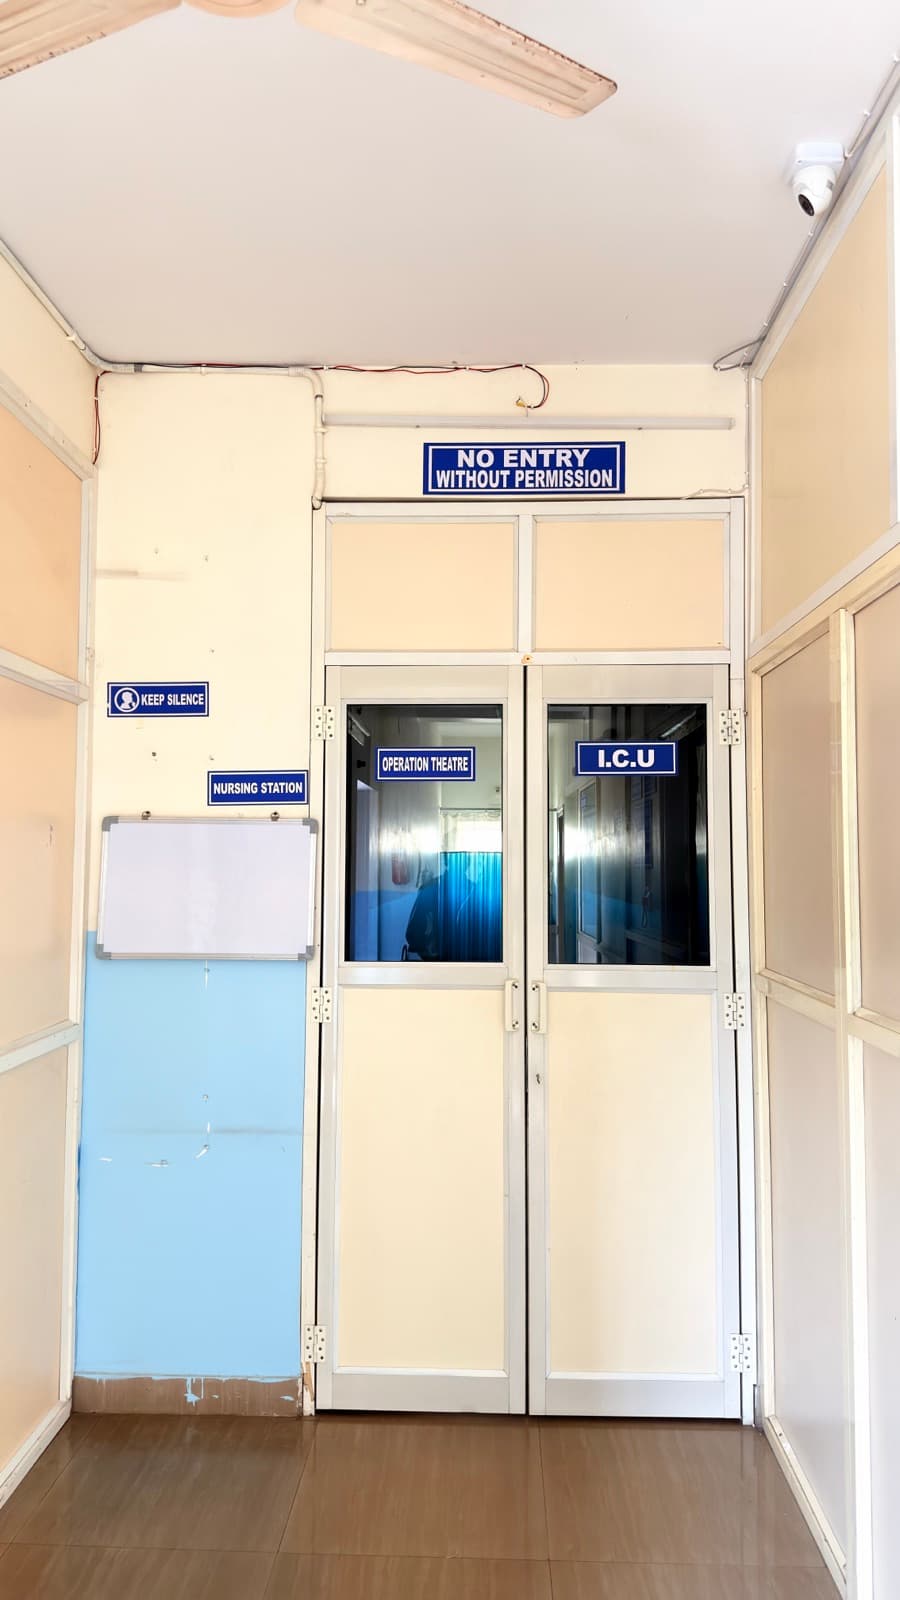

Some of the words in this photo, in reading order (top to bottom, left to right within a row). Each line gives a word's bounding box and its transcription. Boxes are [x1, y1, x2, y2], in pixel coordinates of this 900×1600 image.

[457, 449, 495, 468] NO
[503, 448, 590, 468] ENTRY
[436, 470, 511, 488] WITHOUT
[515, 469, 613, 488] PERMISSION
[141, 693, 165, 706] KEEP
[167, 693, 204, 706] SILENCE
[382, 756, 429, 772] OPERATION
[431, 756, 468, 772] THEATRE
[598, 749, 655, 768] I.C.U
[213, 782, 258, 795] NURSING
[261, 781, 303, 794] STATION
